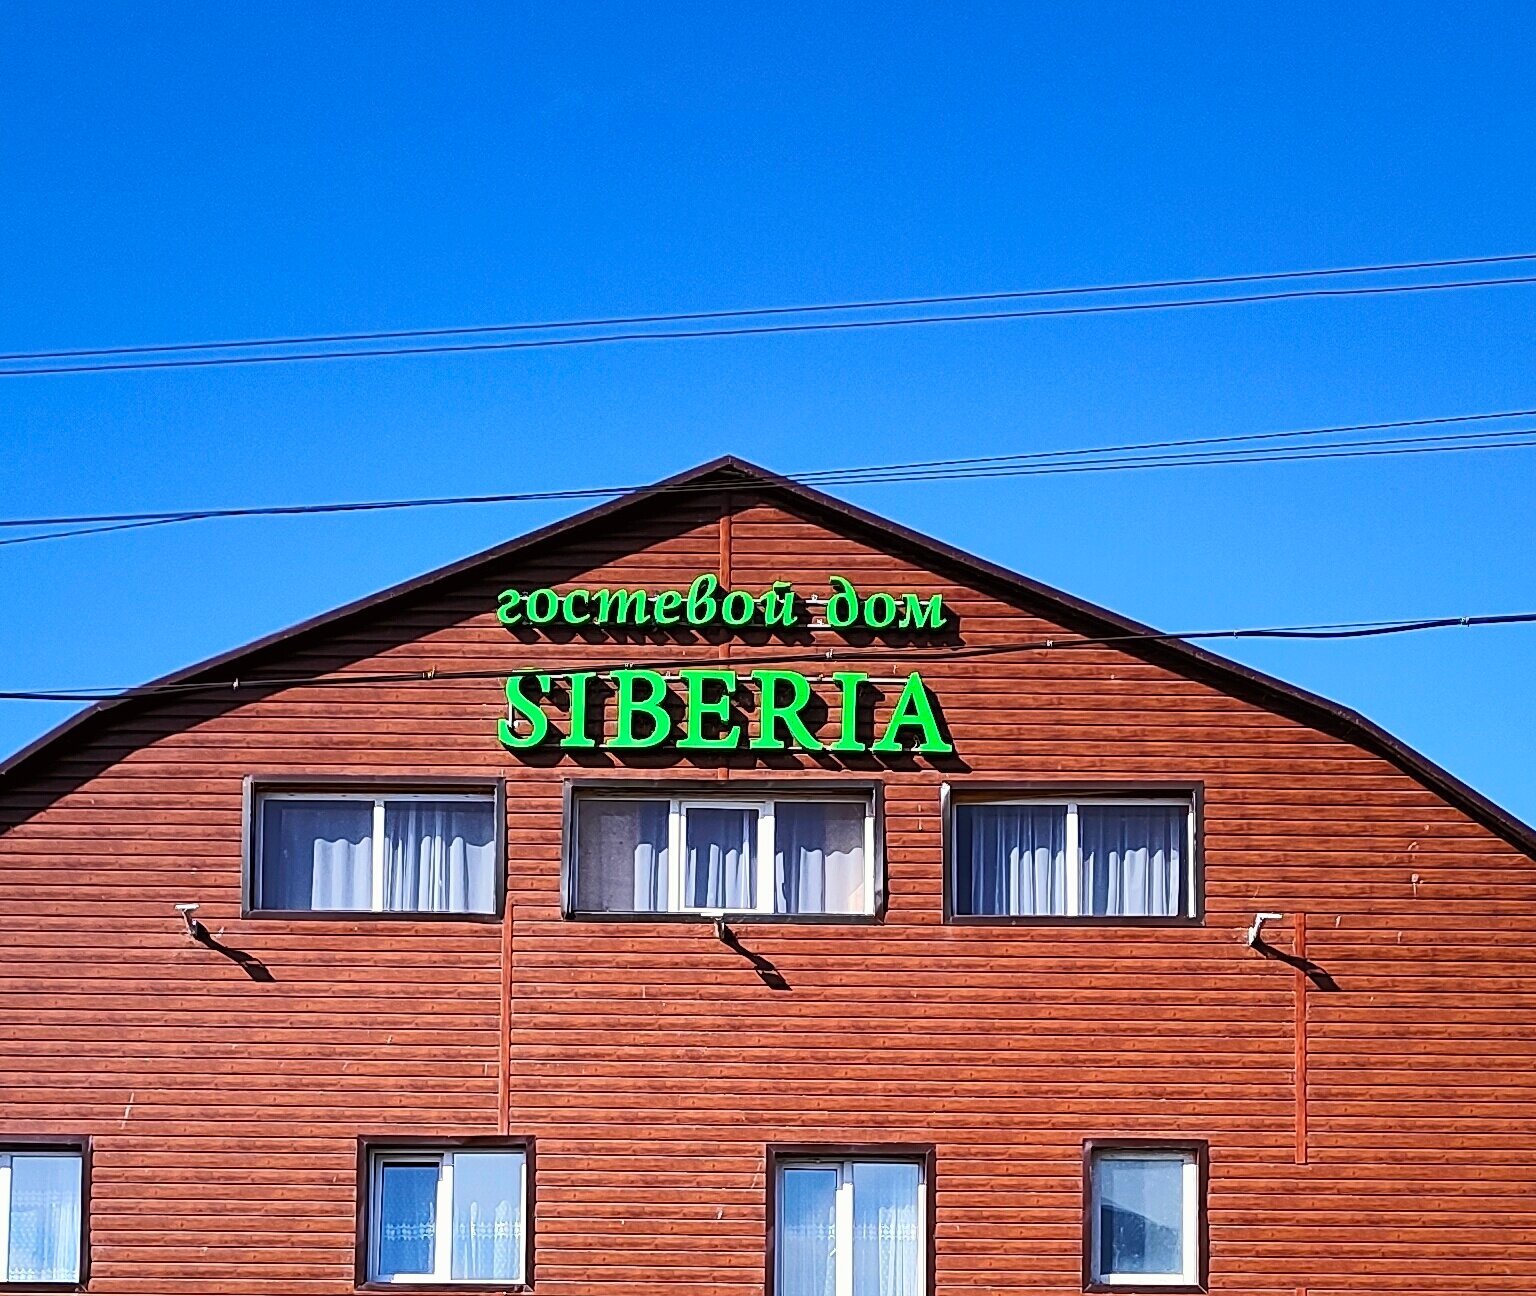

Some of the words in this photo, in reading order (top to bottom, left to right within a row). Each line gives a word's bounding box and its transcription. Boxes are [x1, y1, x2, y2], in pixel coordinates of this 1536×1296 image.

[496, 573, 798, 630] гостевой
[826, 575, 948, 630] дом
[497, 666, 953, 753] SIBERIA
